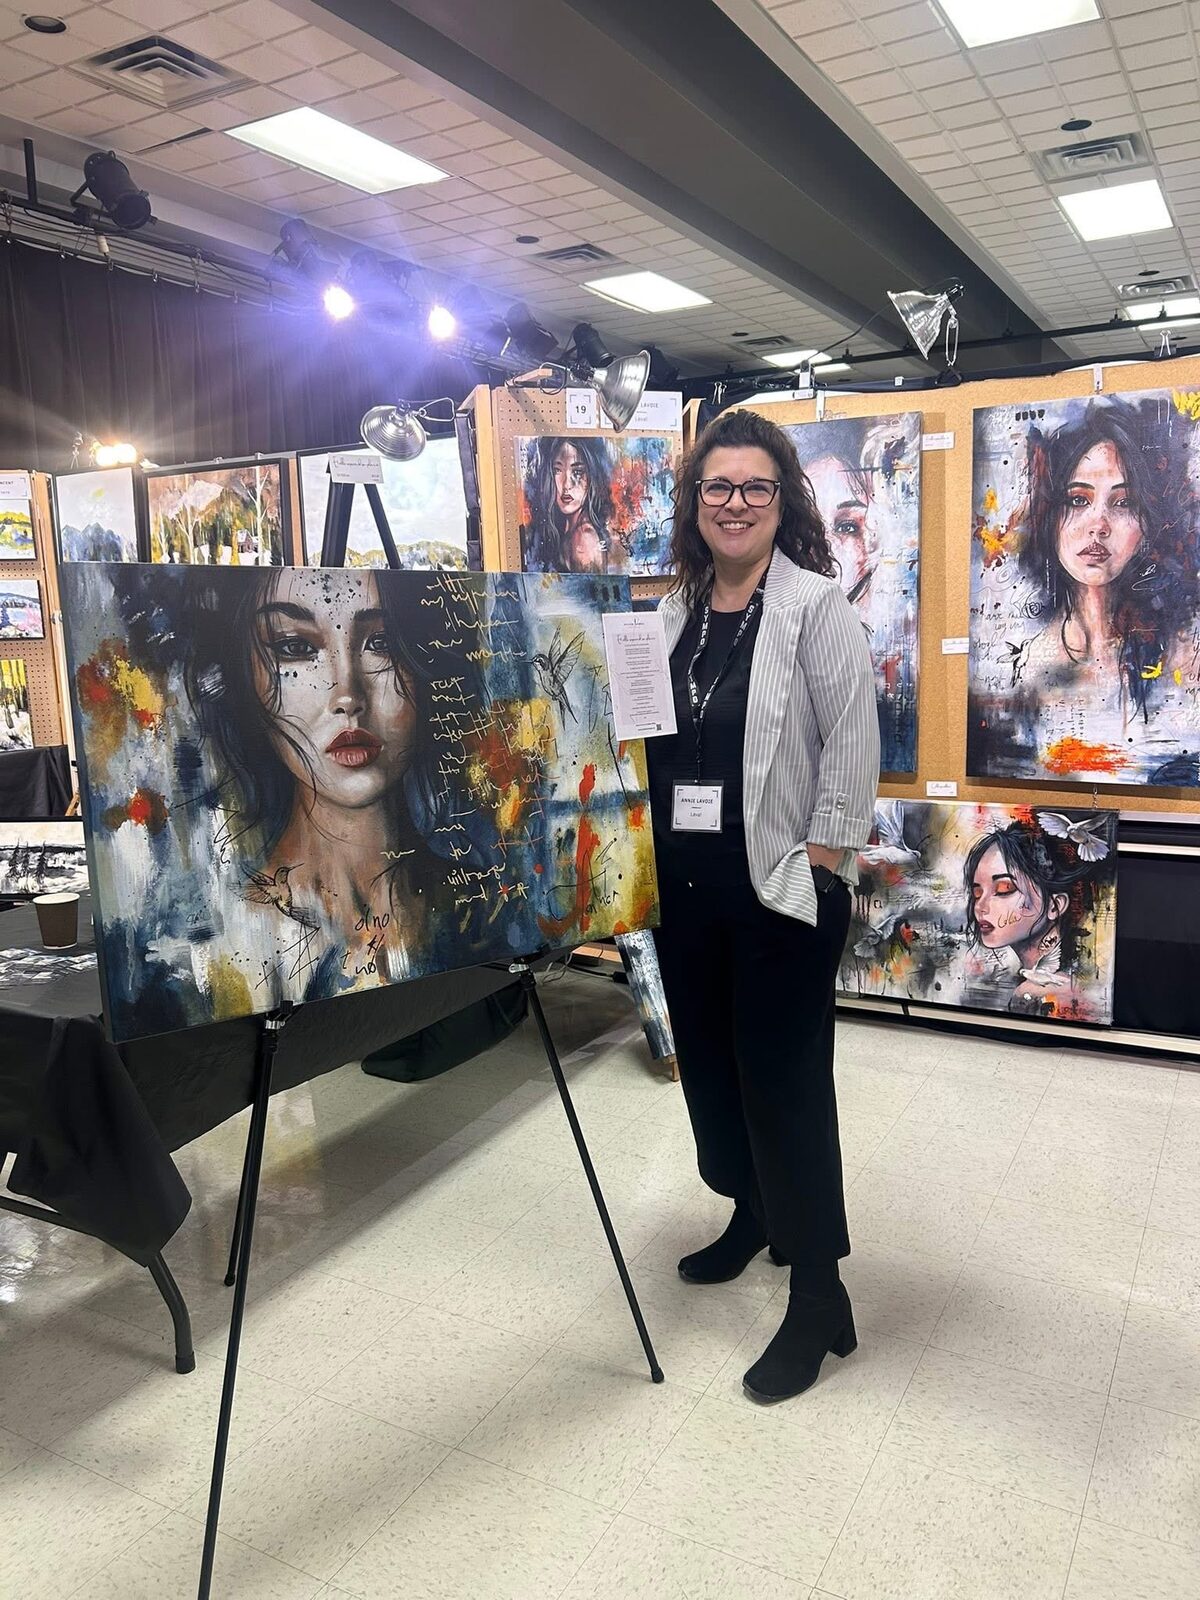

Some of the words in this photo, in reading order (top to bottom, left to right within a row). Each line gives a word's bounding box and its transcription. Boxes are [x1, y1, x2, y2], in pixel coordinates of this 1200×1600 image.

[575, 405, 587, 414] 19
[700, 606, 709, 646] SYMPO
[733, 604, 755, 646] SYMPO
